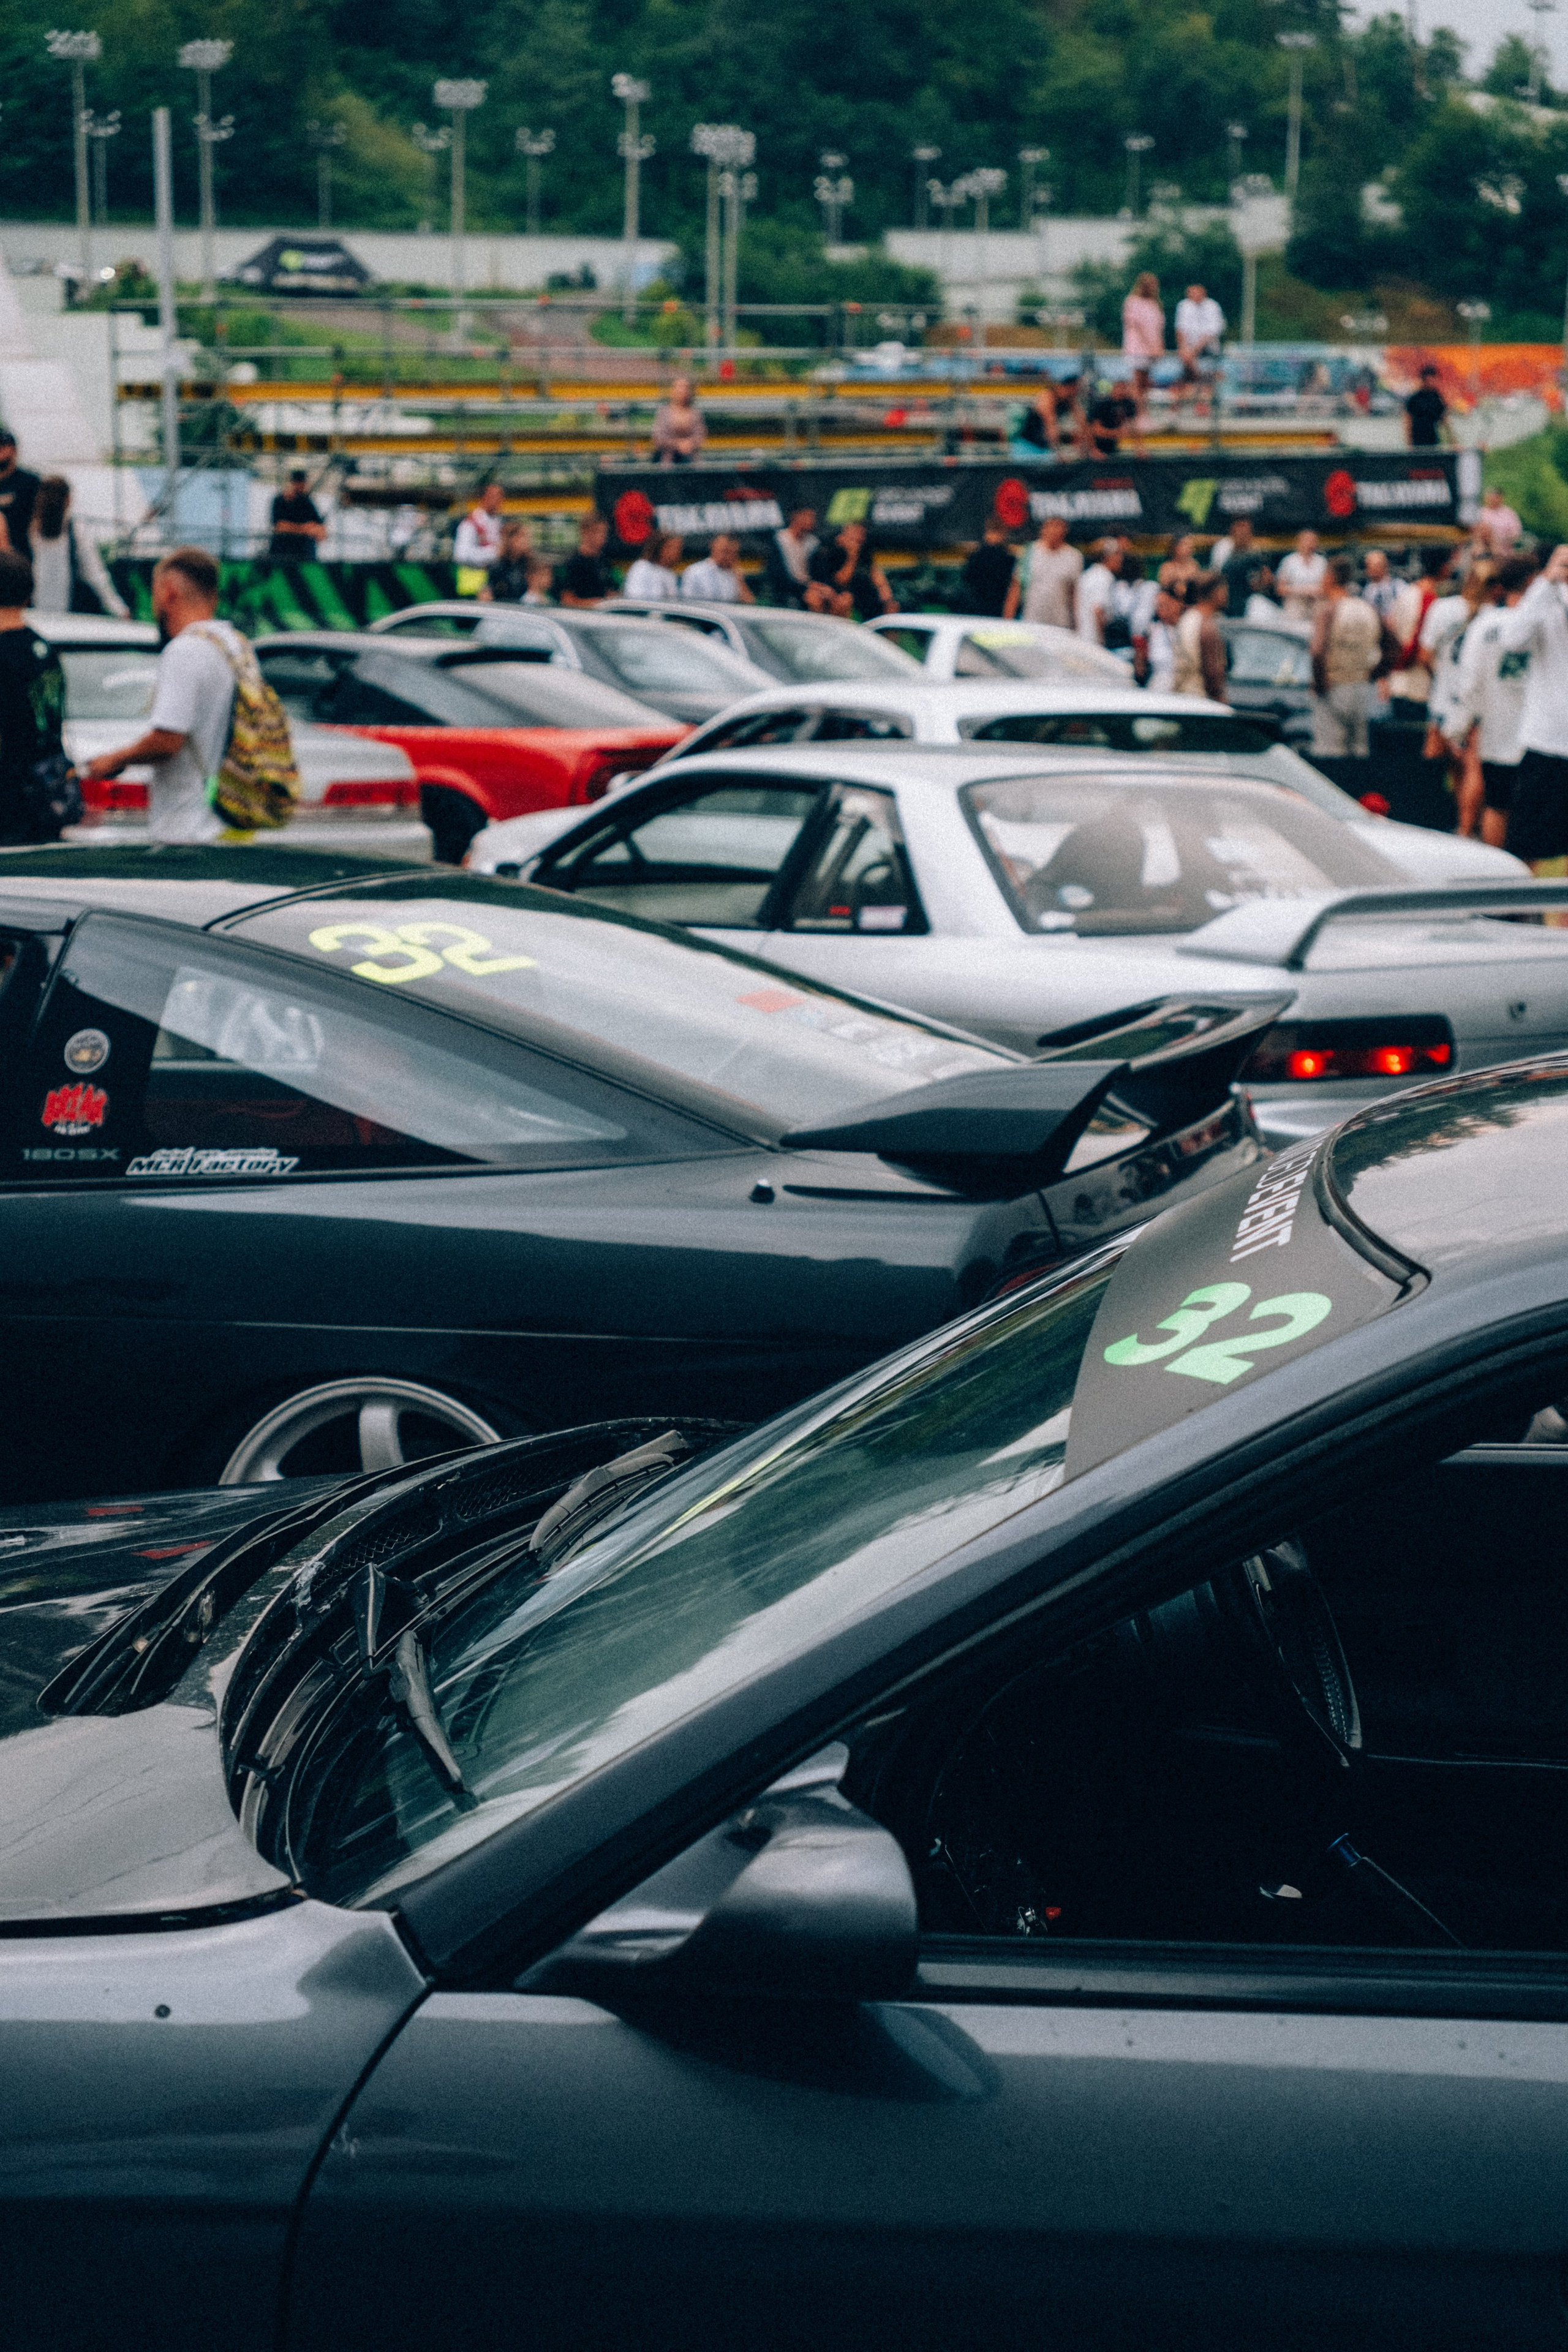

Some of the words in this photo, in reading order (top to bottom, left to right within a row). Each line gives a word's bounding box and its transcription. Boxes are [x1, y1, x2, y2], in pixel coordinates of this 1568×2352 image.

[308, 922, 538, 984] 32
[22, 1147, 119, 1161] 180SX
[1104, 1281, 1332, 1384] 32
